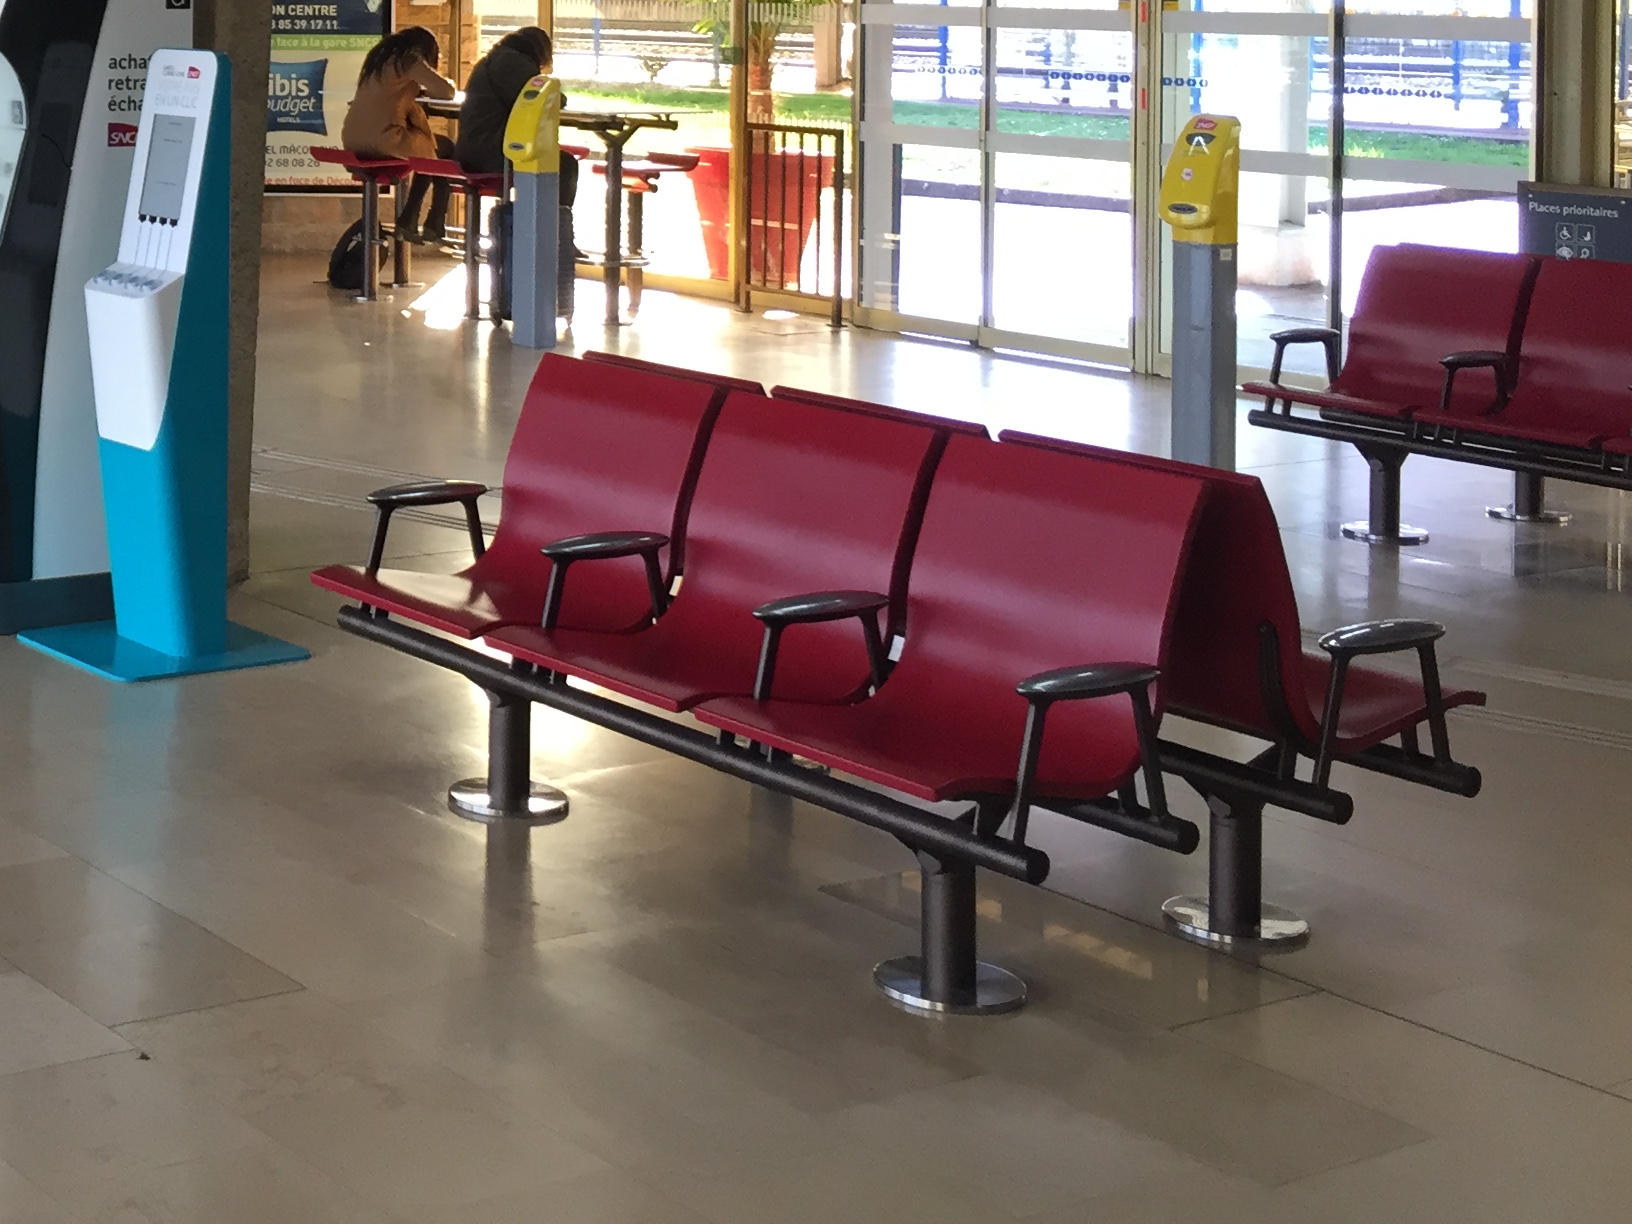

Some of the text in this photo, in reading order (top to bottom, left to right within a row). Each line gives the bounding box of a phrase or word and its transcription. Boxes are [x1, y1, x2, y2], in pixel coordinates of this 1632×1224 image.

[288, 5, 338, 16] CENTRE
[278, 20, 292, 30] 85
[294, 20, 308, 30] 39
[310, 20, 324, 30] 17
[326, 20, 338, 30] 11
[276, 38, 298, 47] face
[322, 39, 348, 48] gare
[268, 74, 310, 96] ibis
[276, 158, 289, 168] 68
[291, 158, 305, 168] 08
[308, 158, 320, 168] 26
[288, 176, 310, 184] face
[1528, 201, 1619, 218] Places prioritaires
